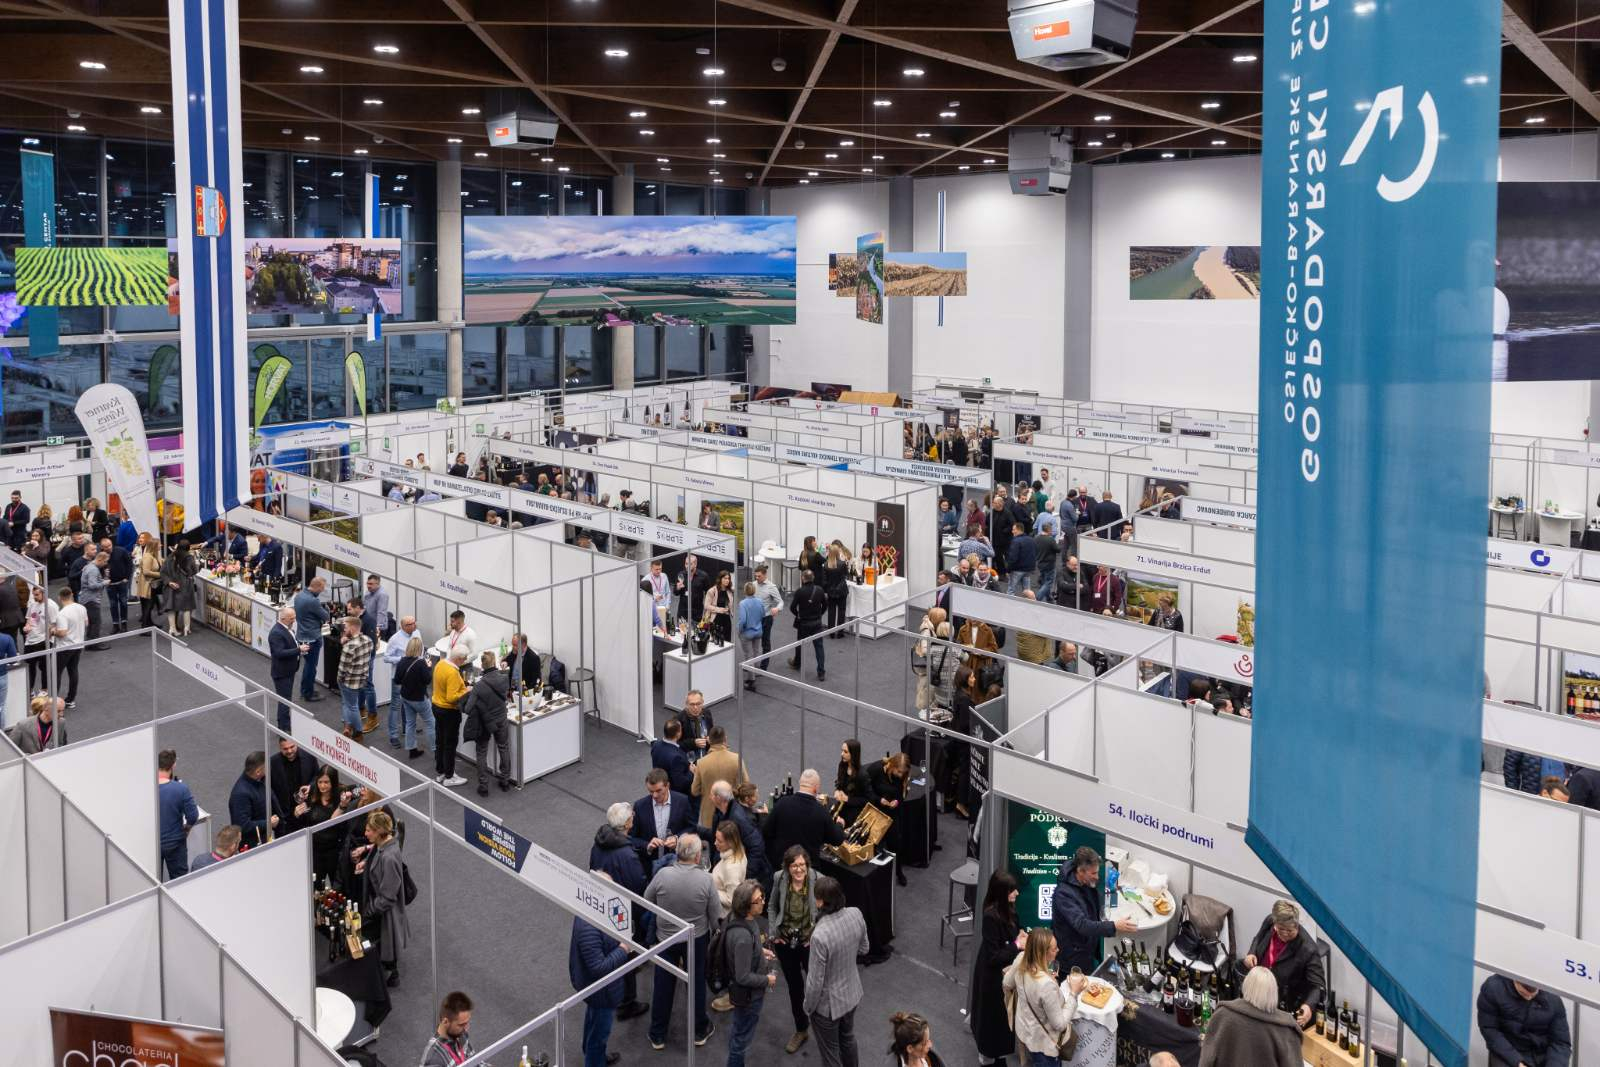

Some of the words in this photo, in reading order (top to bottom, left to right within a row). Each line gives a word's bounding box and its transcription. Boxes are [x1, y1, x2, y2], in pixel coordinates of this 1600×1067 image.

[1147, 557, 1172, 568] Vinarija
[1193, 565, 1211, 574] Erdut
[481, 819, 503, 837] WORLD
[1108, 803, 1126, 818] 54.
[1129, 809, 1159, 829] Iločki
[1162, 823, 1214, 849] podrumi
[492, 834, 516, 852] INSPIRE
[503, 832, 516, 845] THE
[491, 848, 516, 868] FOLLOW
[498, 844, 515, 860] YOUR
[576, 887, 605, 914] FERIT
[1564, 959, 1593, 980] 53.
[97, 1041, 172, 1060] CHOCOLATERIA
